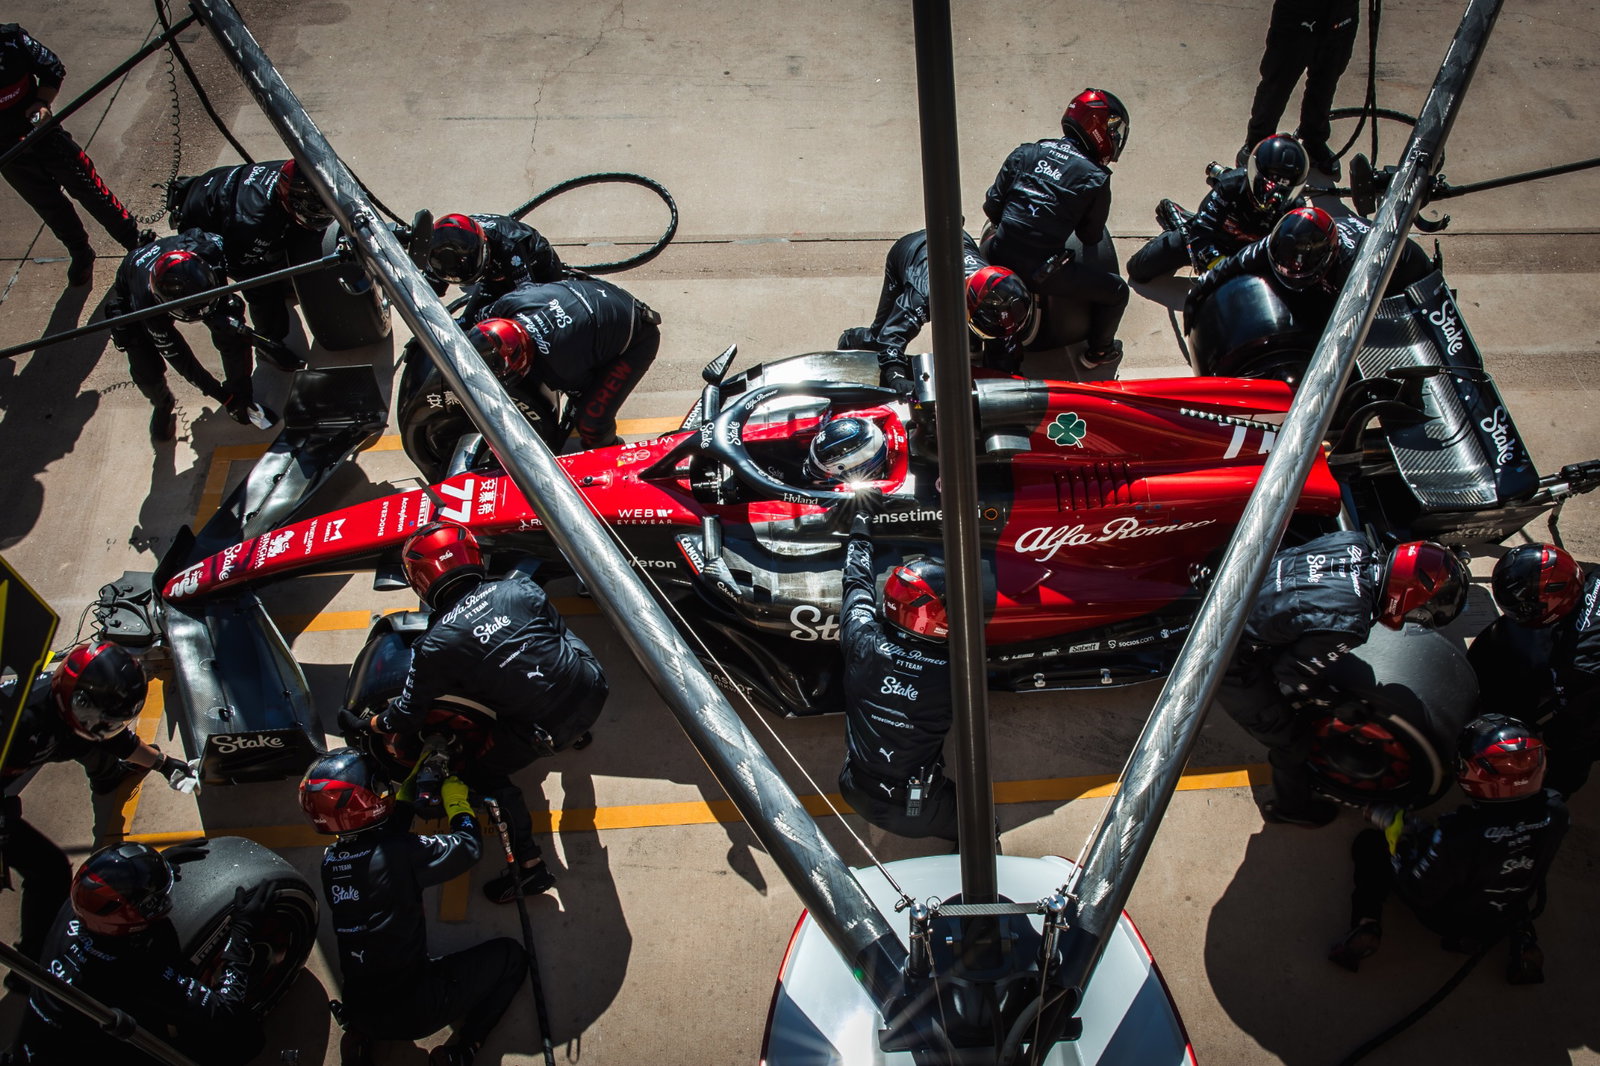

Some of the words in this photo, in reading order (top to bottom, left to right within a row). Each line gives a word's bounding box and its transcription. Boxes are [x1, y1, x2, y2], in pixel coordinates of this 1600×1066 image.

[1034, 160, 1063, 181] Stake
[548, 298, 573, 330] Stake
[1429, 299, 1464, 356] Stake
[585, 360, 634, 418] CREW
[700, 421, 715, 449] Stake
[727, 420, 742, 446] Stake
[1480, 404, 1517, 466] Stake
[436, 478, 475, 523] 77
[783, 492, 819, 505] Hyland
[617, 508, 655, 518] WEB
[872, 508, 943, 524] ensetime
[256, 531, 272, 568] SINGHA
[1014, 523, 1097, 562] Alfa
[1096, 516, 1218, 543] Romeo
[218, 542, 244, 581] Stake
[1306, 553, 1327, 584] Stake
[441, 602, 467, 625] Alfa
[464, 584, 498, 610] Romeo
[471, 600, 489, 615] TEAM
[472, 615, 513, 645] Stake
[1118, 635, 1155, 648] socios.com
[879, 642, 907, 657] Alfa
[906, 649, 948, 666] Romeo
[905, 661, 924, 671] TEAM
[880, 675, 919, 701] Stake
[211, 734, 285, 754] Stake
[331, 884, 360, 905] Stake
